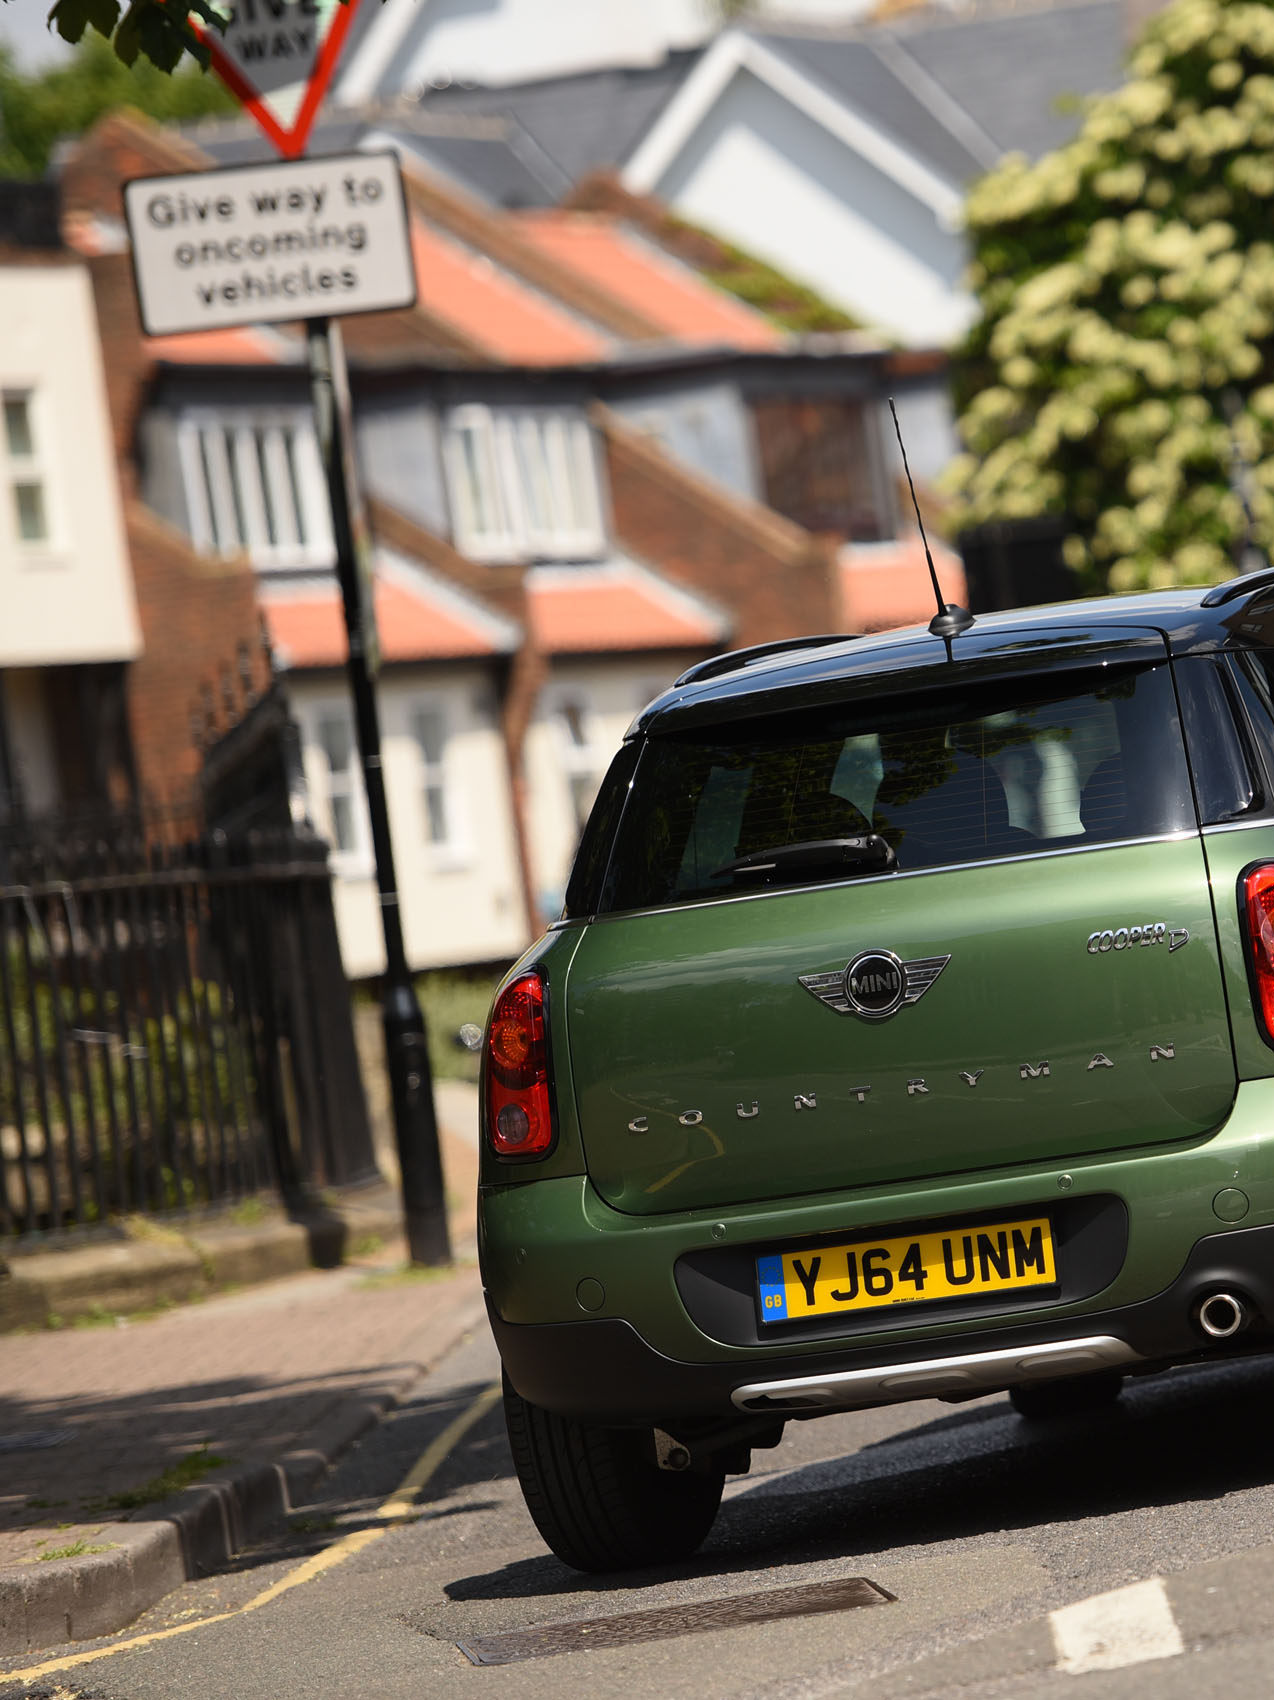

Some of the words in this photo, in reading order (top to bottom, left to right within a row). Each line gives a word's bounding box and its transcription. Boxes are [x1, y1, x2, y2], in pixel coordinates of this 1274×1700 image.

[238, 29, 311, 60] WAY
[148, 191, 234, 228] Give
[251, 182, 327, 214] way
[343, 174, 384, 206] to
[175, 223, 368, 268] oncoming
[197, 263, 358, 304] vehicles
[1087, 922, 1166, 954] COOPER
[1168, 928, 1190, 952] D
[851, 971, 899, 996] MINI
[628, 1042, 1176, 1133] COUNTRYMAN
[792, 1243, 928, 1306] YJ64
[941, 1226, 1046, 1286] UNM
[764, 1294, 783, 1309] GB
